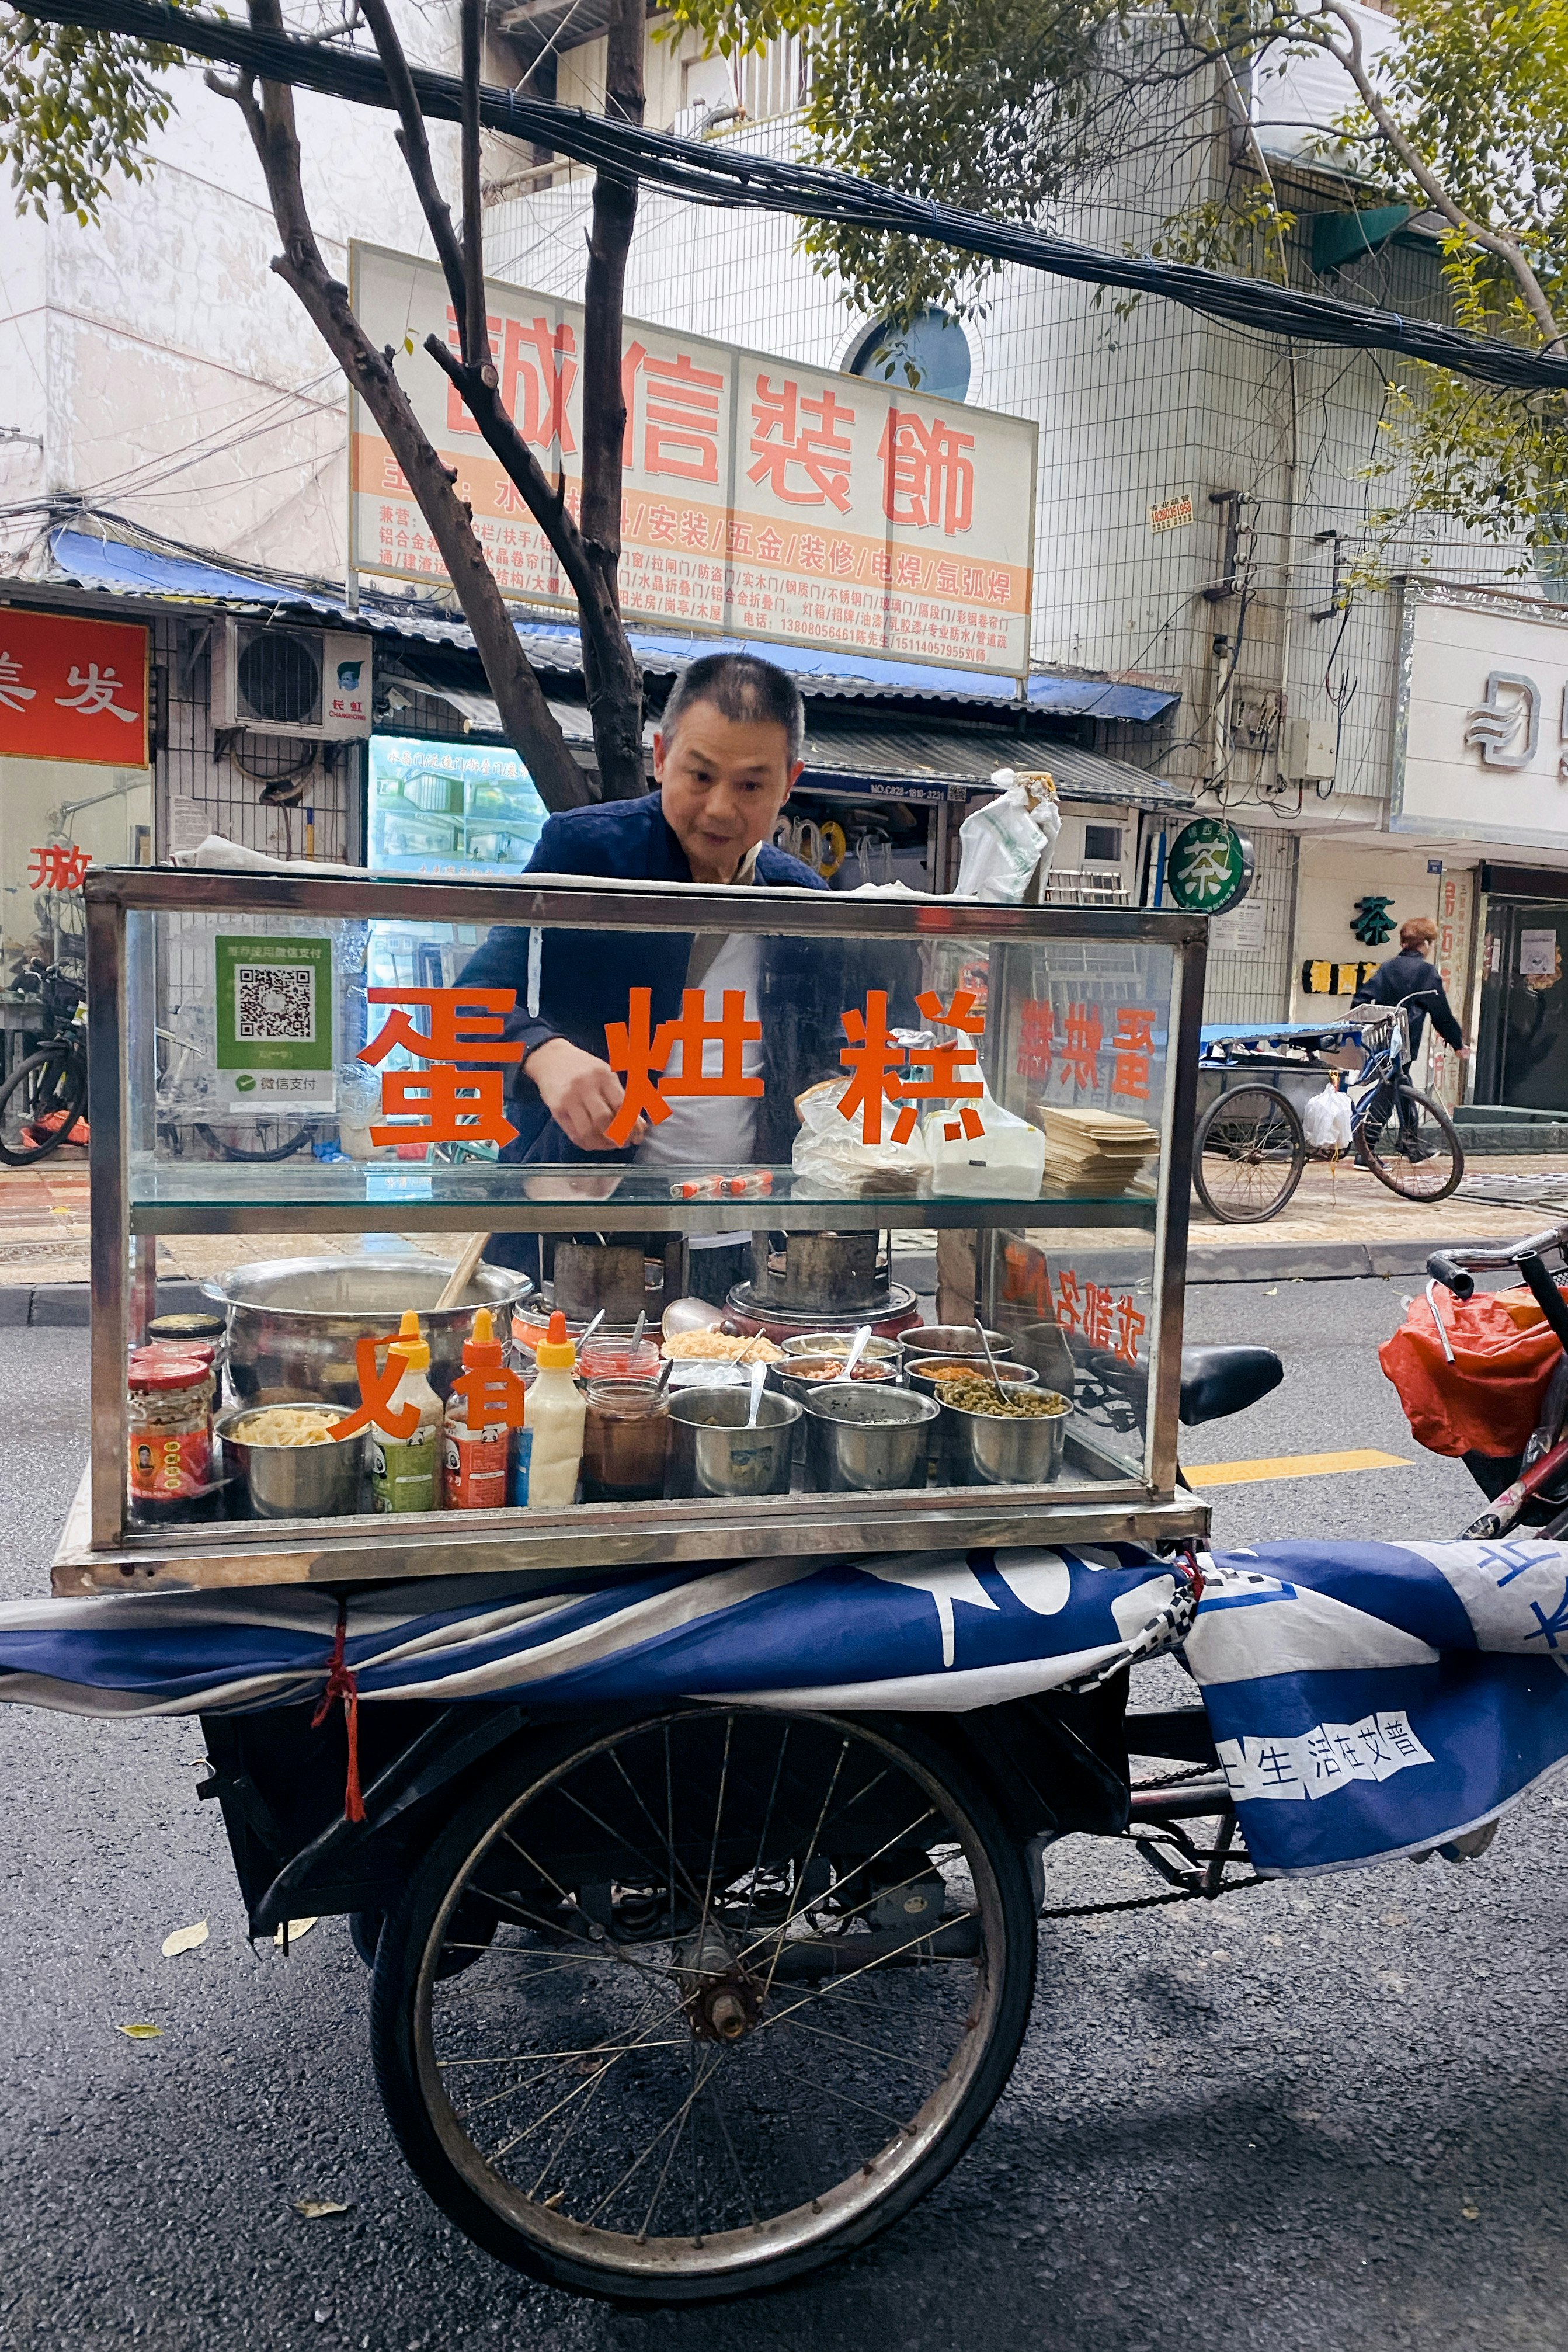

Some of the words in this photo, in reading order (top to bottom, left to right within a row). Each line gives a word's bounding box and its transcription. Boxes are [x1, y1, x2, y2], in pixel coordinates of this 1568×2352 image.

[1151, 501, 1191, 523] 18280351958
[332, 699, 362, 712] 长虹
[1177, 832, 1232, 901] 茶
[1350, 897, 1398, 946] 茶
[260, 1078, 316, 1090] 微信支付
